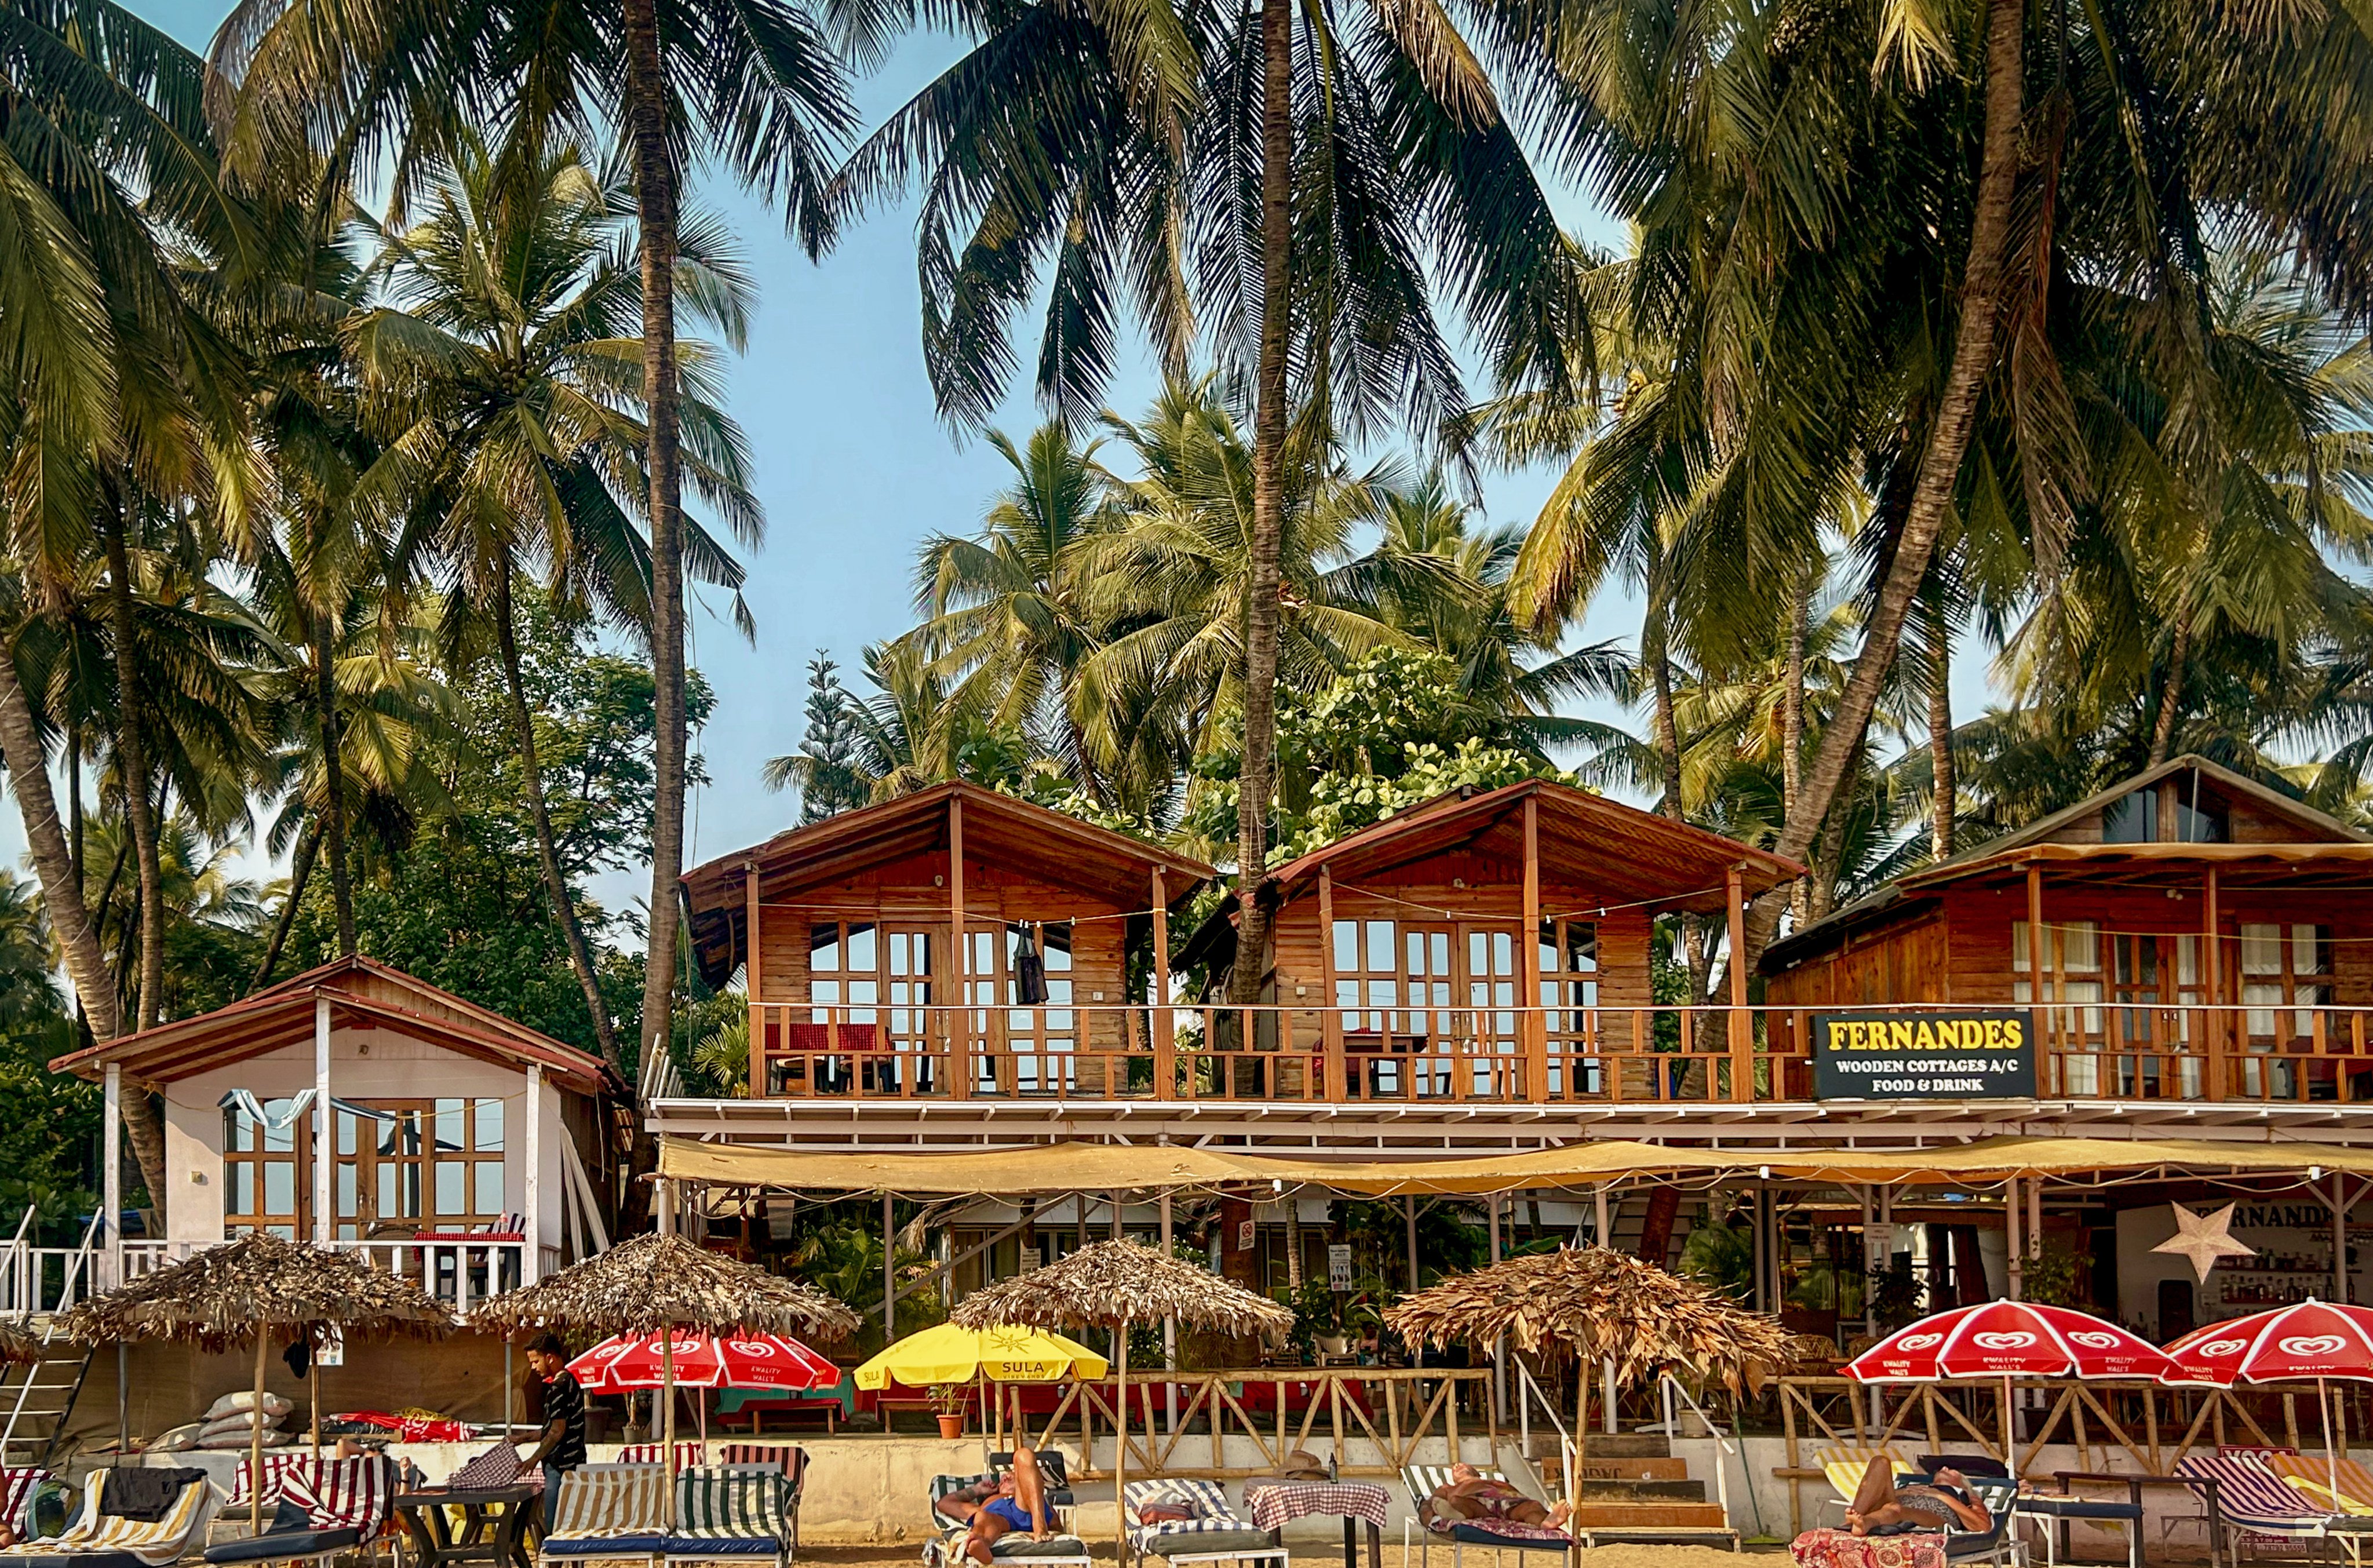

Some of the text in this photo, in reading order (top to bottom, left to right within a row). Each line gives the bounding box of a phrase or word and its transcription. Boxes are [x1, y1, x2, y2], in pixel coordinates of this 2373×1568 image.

[1827, 1019, 2022, 1051] FERNANDES
[1836, 1059, 2018, 1074] WOODEN COTTAGES A/C
[1872, 1078, 1984, 1092] FOOD & DRINK
[751, 1366, 781, 1374] KWALITY
[1003, 1362, 1044, 1373] SULA
